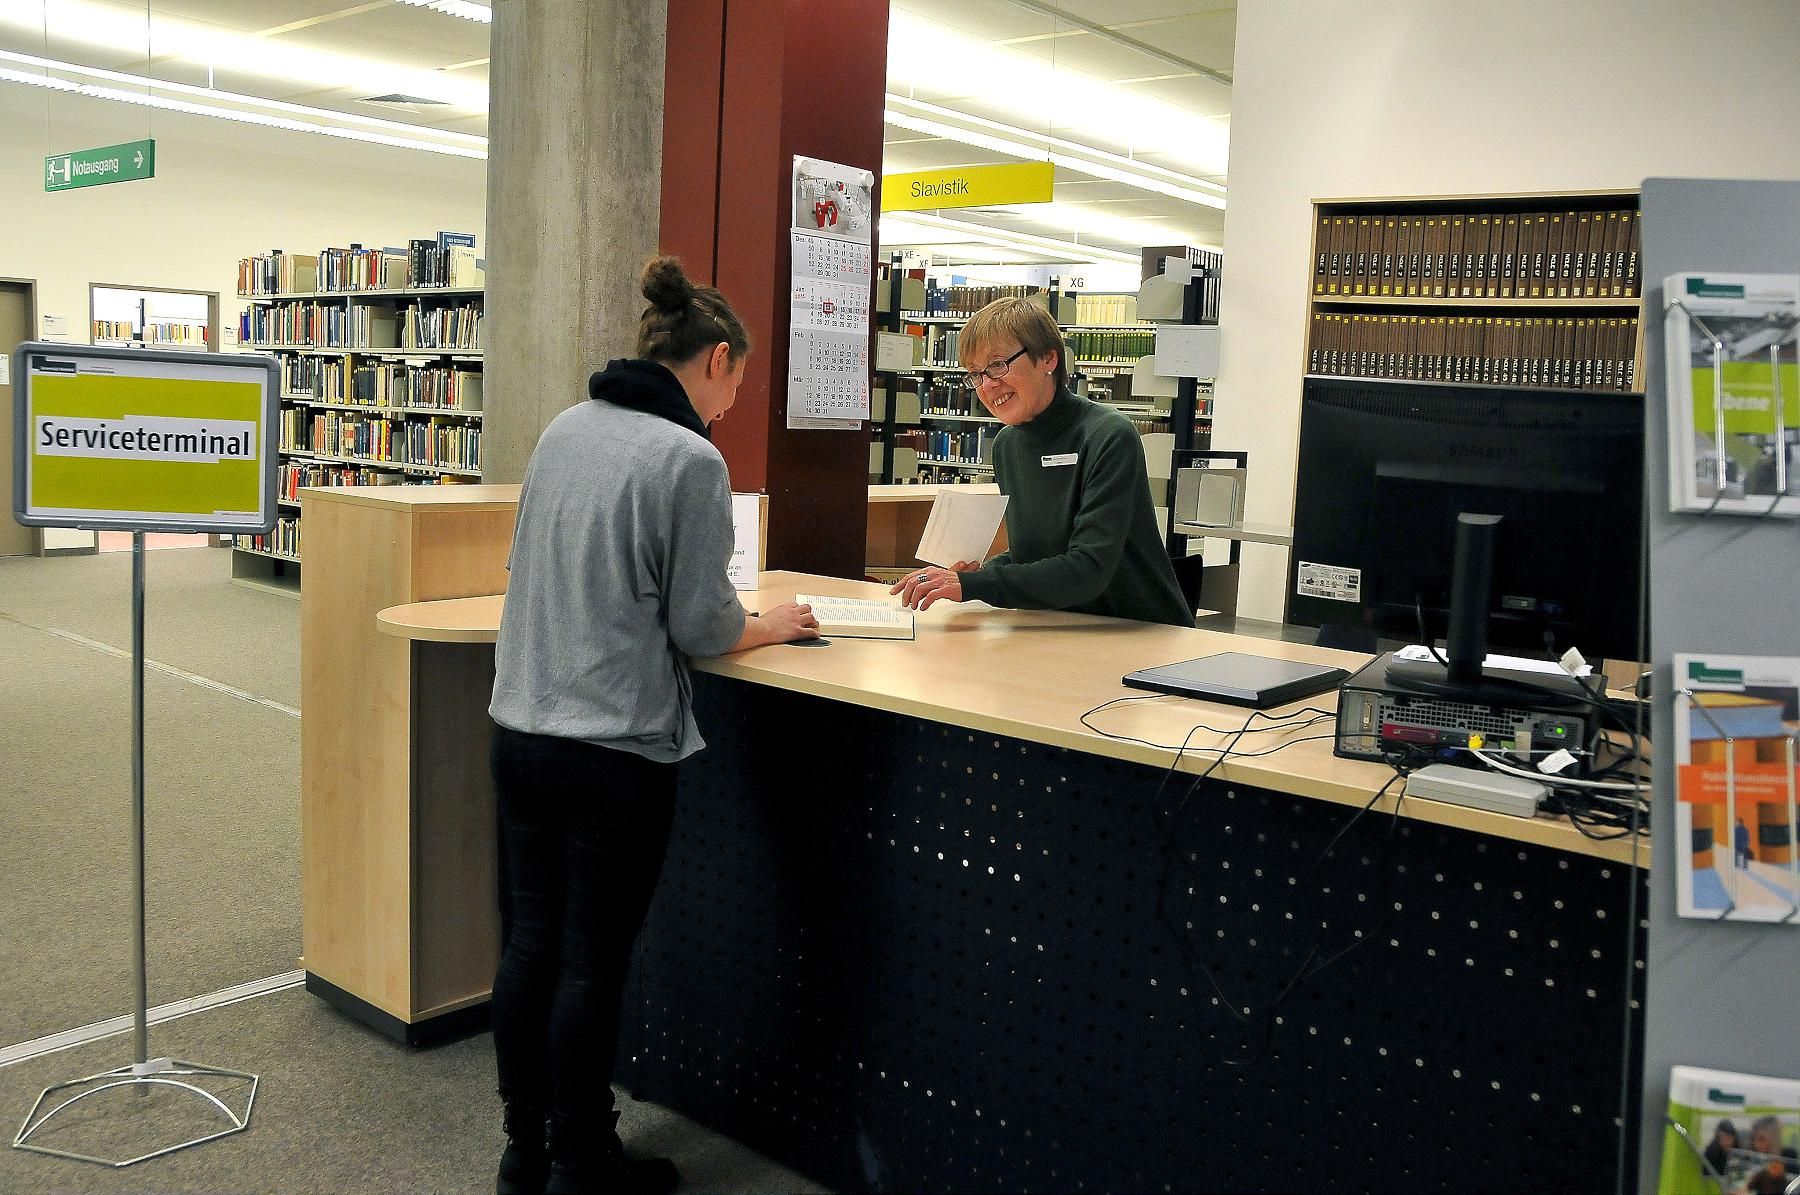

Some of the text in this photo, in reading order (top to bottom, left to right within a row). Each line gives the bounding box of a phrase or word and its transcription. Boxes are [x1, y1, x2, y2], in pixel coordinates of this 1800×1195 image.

[72, 158, 118, 176] Notausgang
[911, 178, 969, 198] Slavistik
[1070, 278, 1084, 288] XG
[41, 422, 250, 456] Serviceterminal
